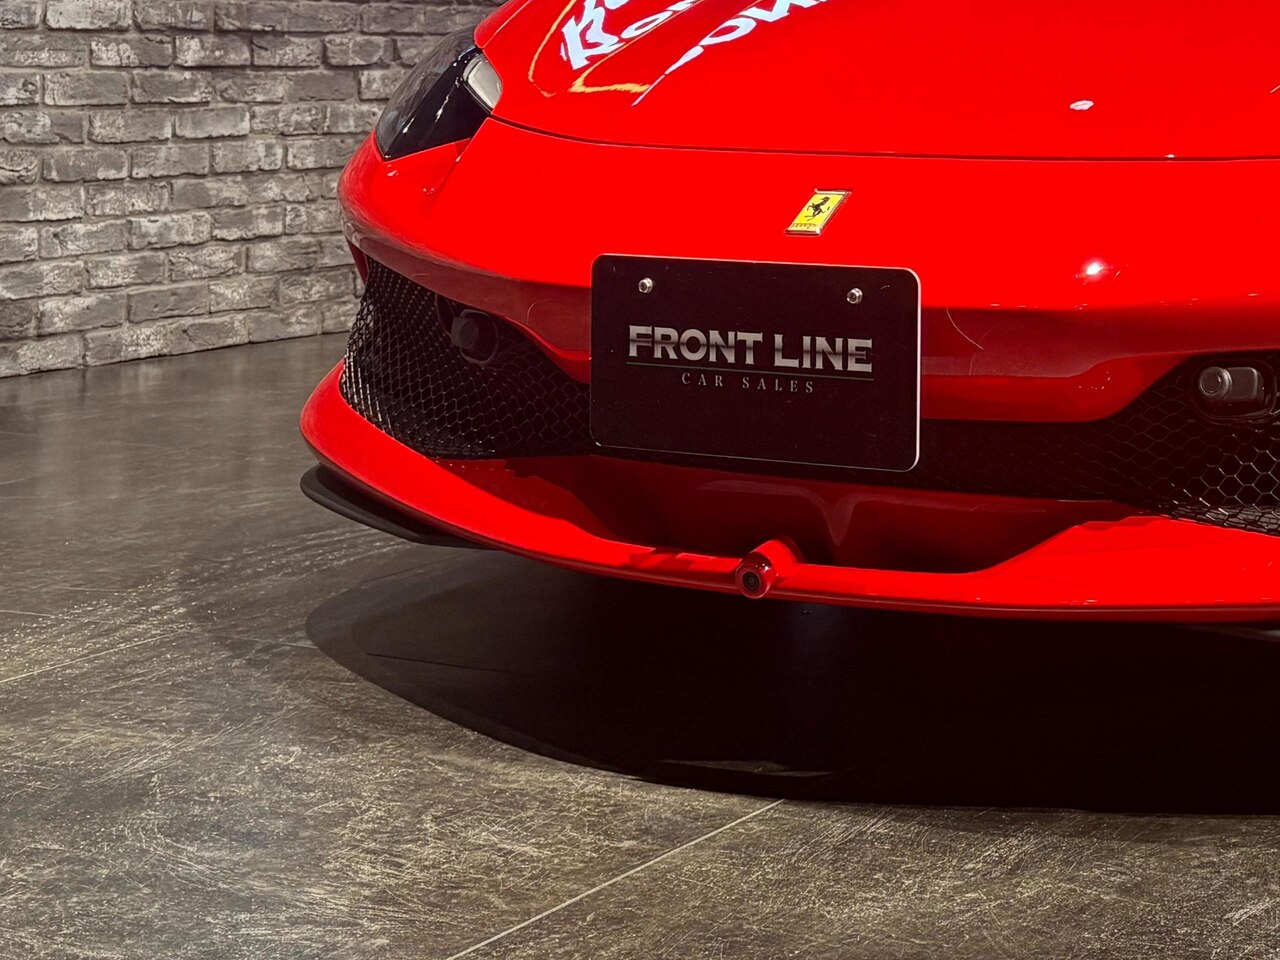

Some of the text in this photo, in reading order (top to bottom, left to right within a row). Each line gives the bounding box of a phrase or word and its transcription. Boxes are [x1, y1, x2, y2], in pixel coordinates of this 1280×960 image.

[628, 324, 873, 373] FRONT LINE
[681, 371, 815, 394] CAR SALES
